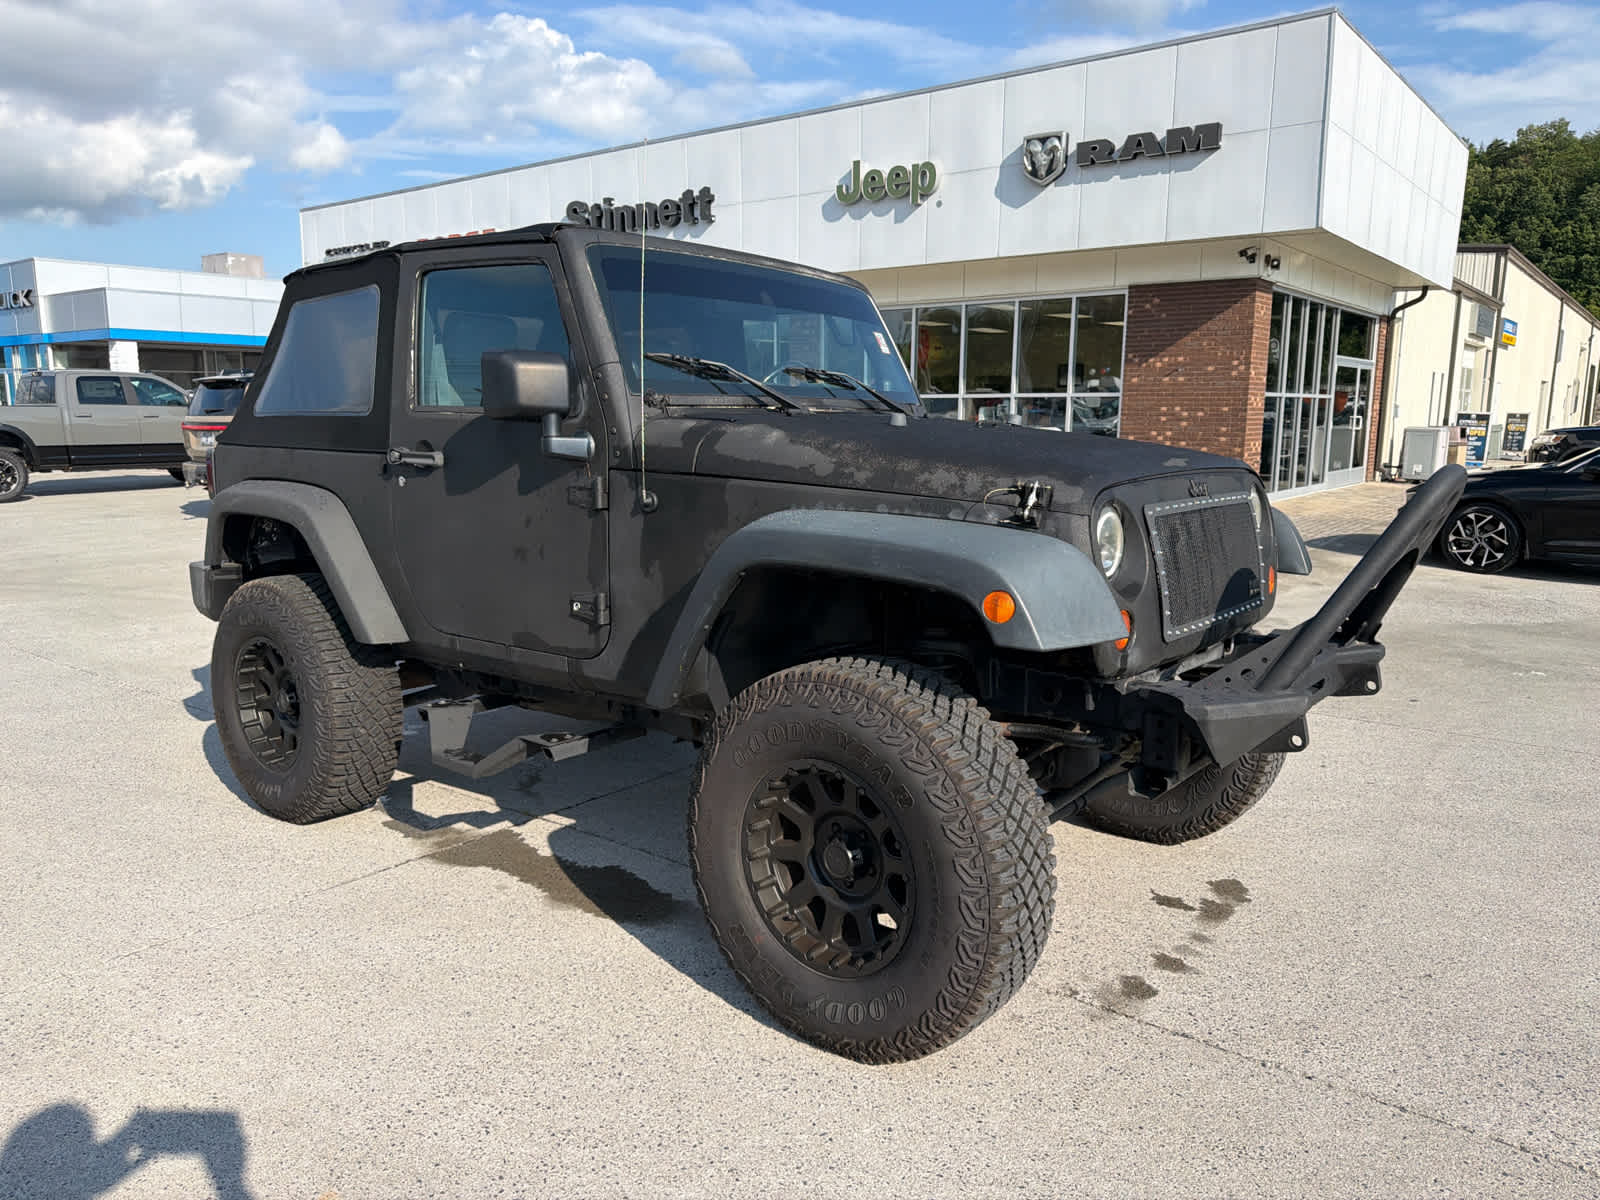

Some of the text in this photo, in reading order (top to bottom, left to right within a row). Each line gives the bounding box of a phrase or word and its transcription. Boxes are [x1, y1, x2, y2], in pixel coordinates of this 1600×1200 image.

[1076, 122, 1223, 167] RAM
[836, 159, 938, 206] Jeep
[566, 186, 715, 232] Stinnett
